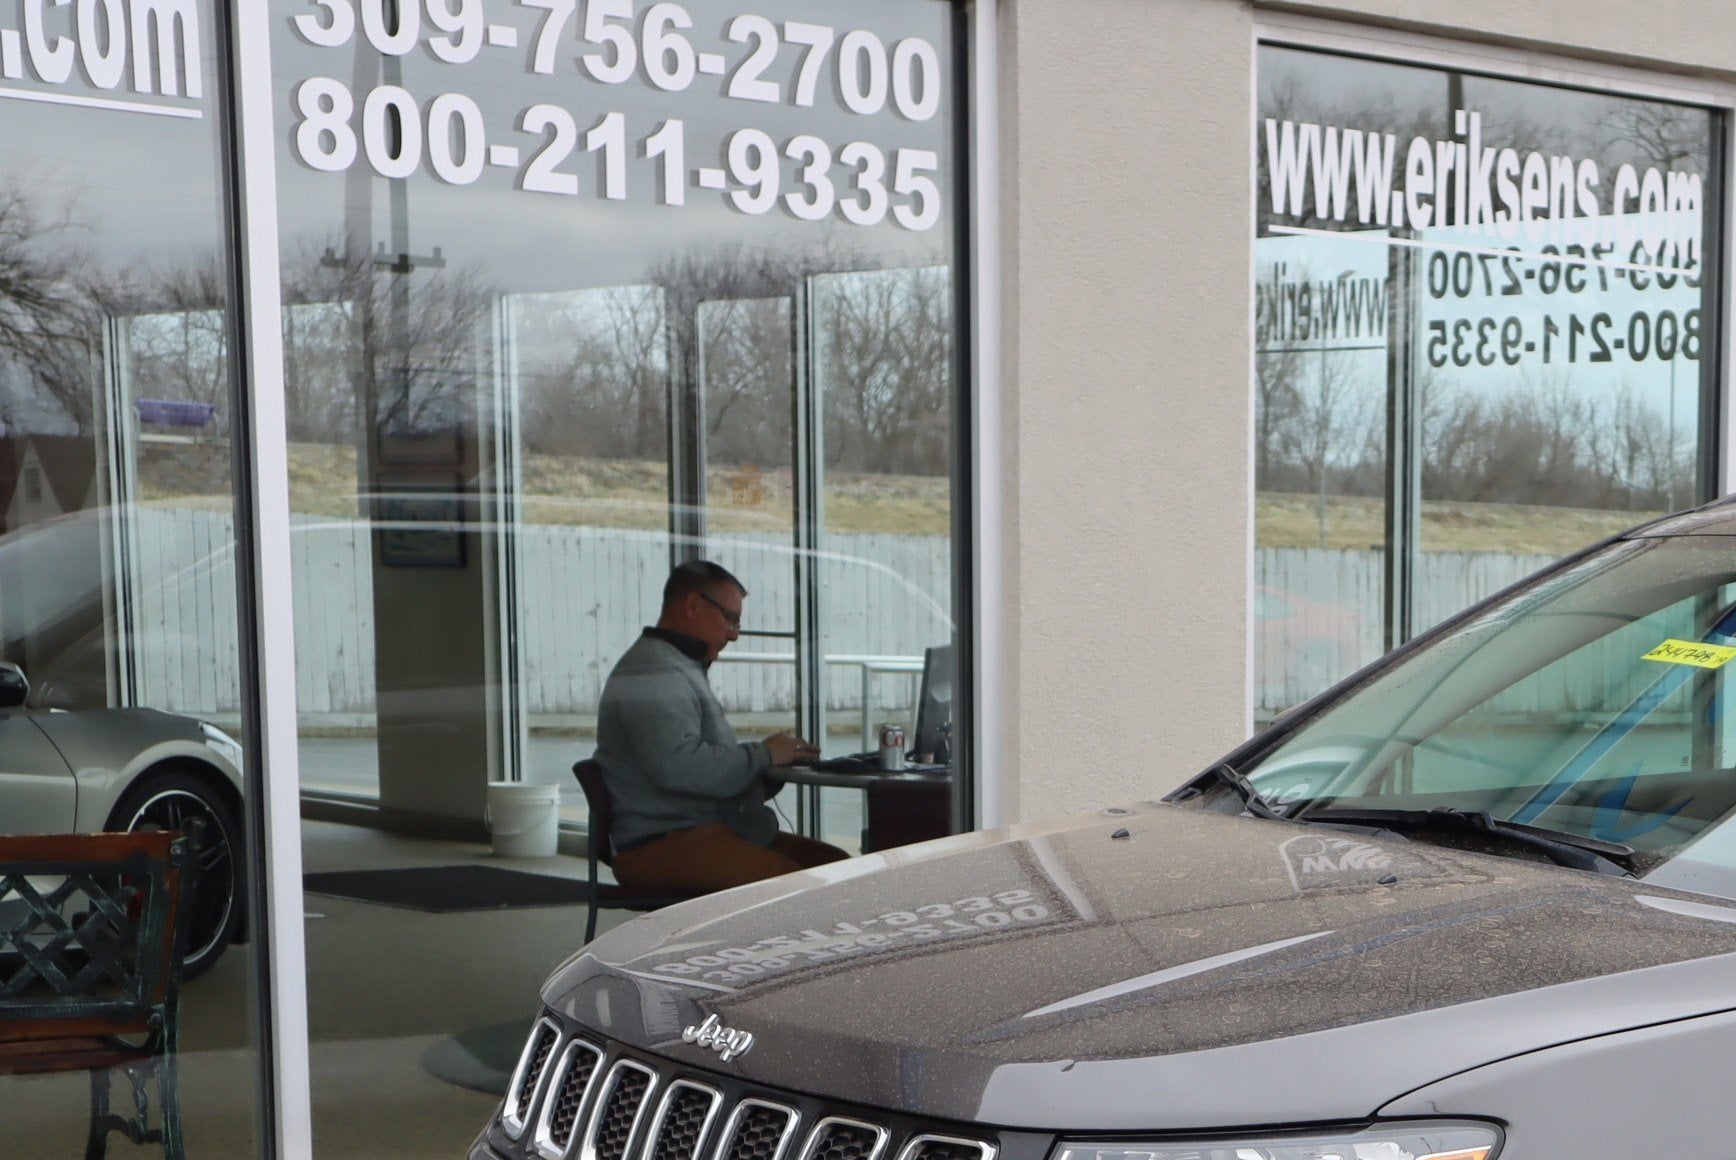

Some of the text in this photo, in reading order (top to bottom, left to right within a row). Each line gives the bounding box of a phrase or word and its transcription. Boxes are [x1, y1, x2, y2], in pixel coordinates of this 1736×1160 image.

[295, 77, 941, 231] 800-211-9335
[1265, 109, 1703, 268] www.eriksens.com
[682, 1013, 753, 1062] Jeep
